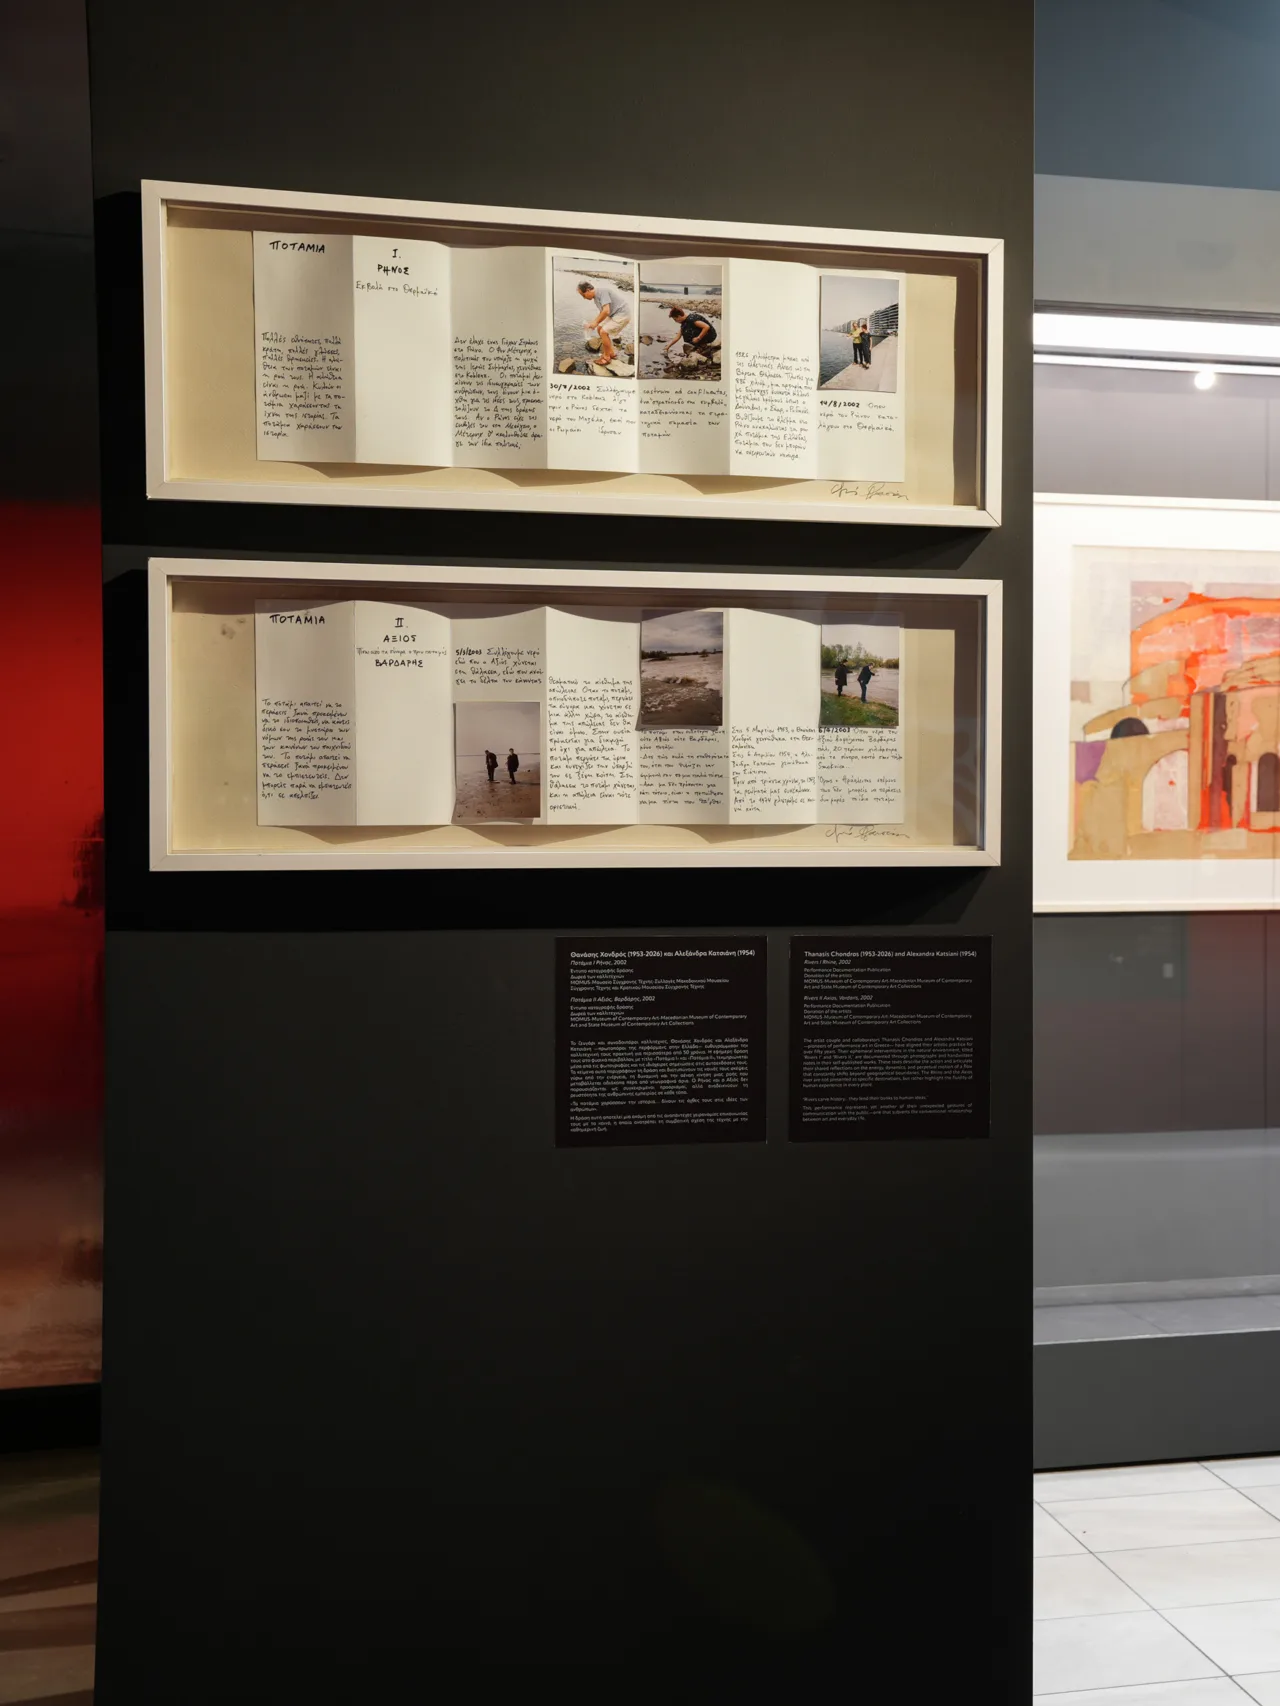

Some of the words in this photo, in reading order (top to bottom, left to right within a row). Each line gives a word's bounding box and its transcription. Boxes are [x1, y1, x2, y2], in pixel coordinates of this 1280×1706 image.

[269, 241, 326, 254] ΠΟΤΑΜΙΑ
[377, 263, 410, 276] ΡΗΝΟΣ
[269, 614, 326, 626] ΠΟΤΑΜΙΑ
[382, 634, 417, 643] ΑΞΙΟΣ
[374, 658, 424, 668] ΒΑΡΔΑΡΗΣ
[570, 951, 598, 959] Θανάσης
[600, 951, 626, 959] Χονδρός
[674, 950, 708, 958] Αλεξάνδρα
[708, 950, 736, 958] Κατσιάνη
[737, 949, 756, 957] (1954)
[959, 950, 977, 958] (1954)
